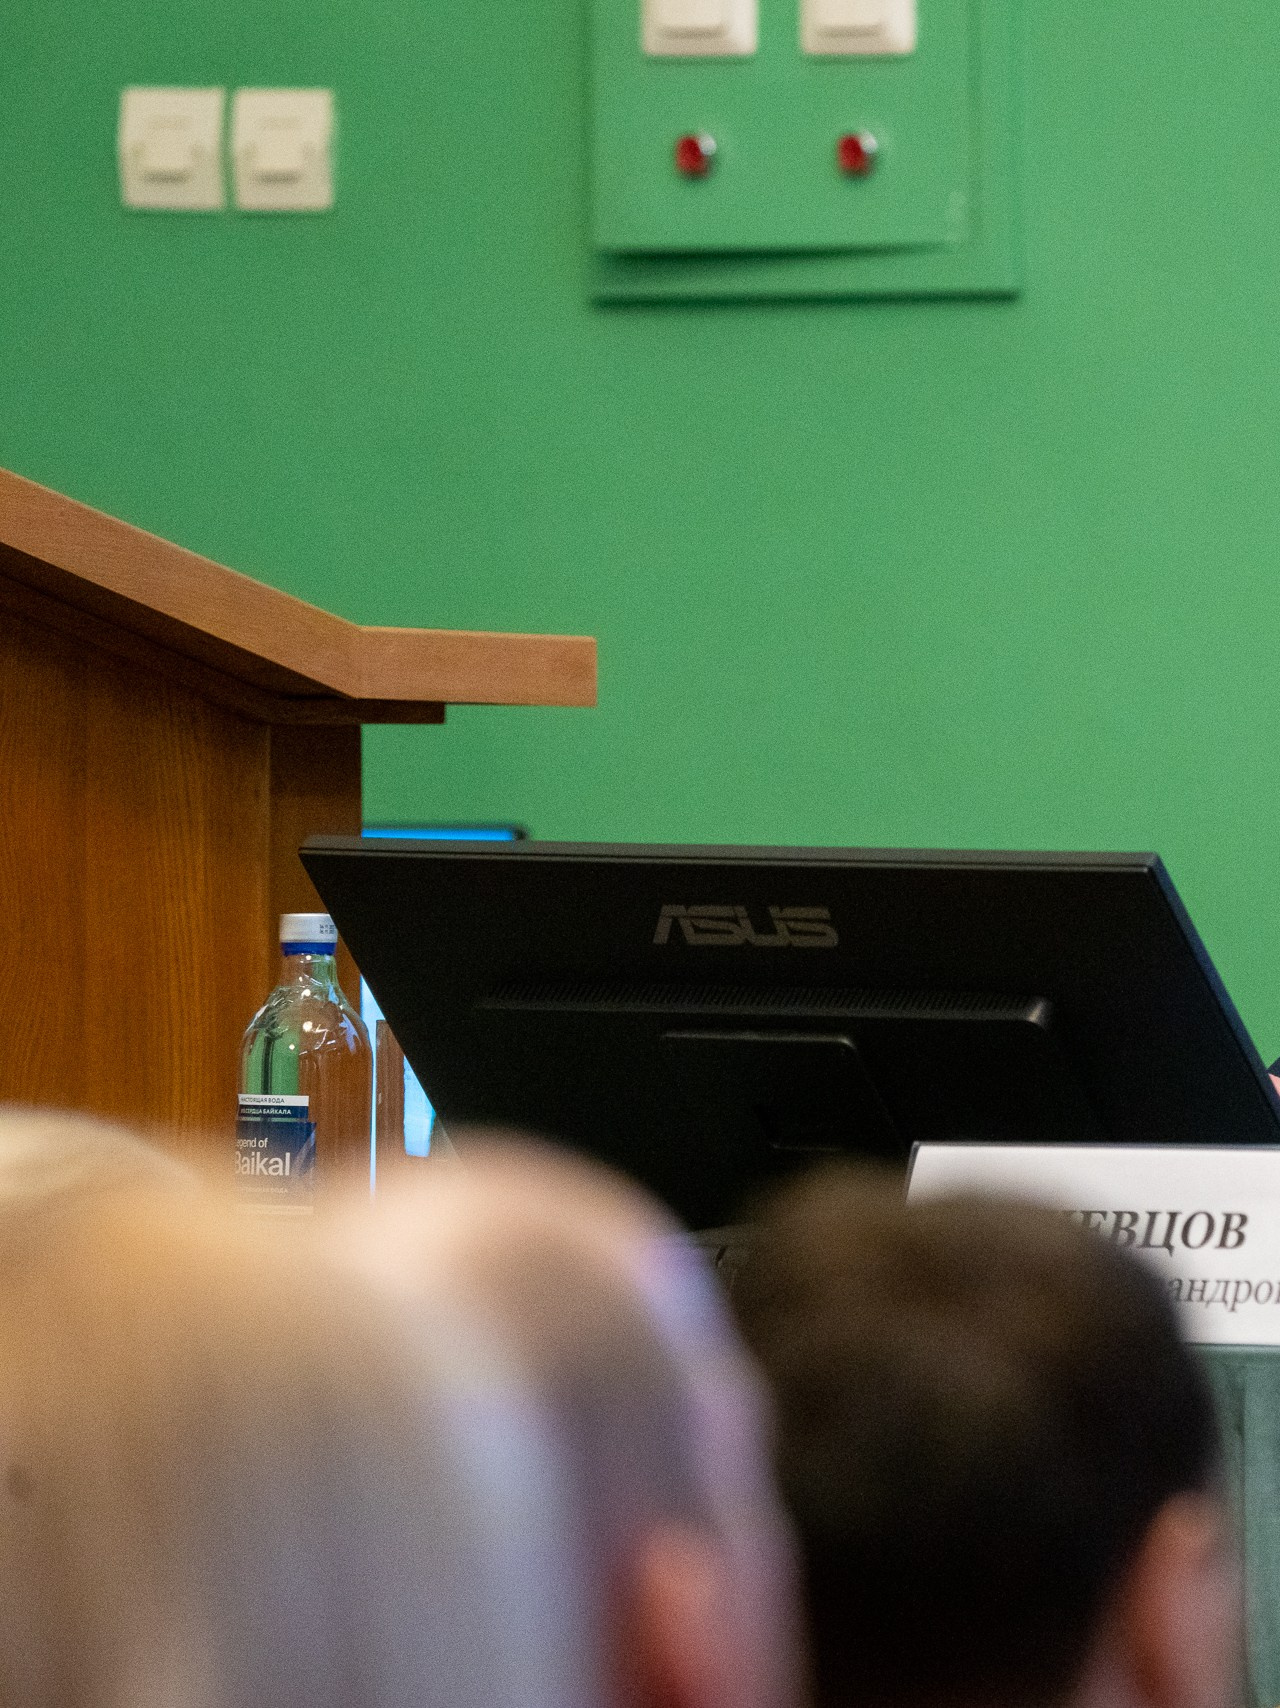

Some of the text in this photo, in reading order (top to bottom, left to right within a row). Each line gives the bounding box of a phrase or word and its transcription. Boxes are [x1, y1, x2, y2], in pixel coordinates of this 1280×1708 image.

[652, 904, 839, 947] ASUS
[258, 1137, 268, 1148] of
[1064, 1210, 1249, 1255] ЕВЦОВ
